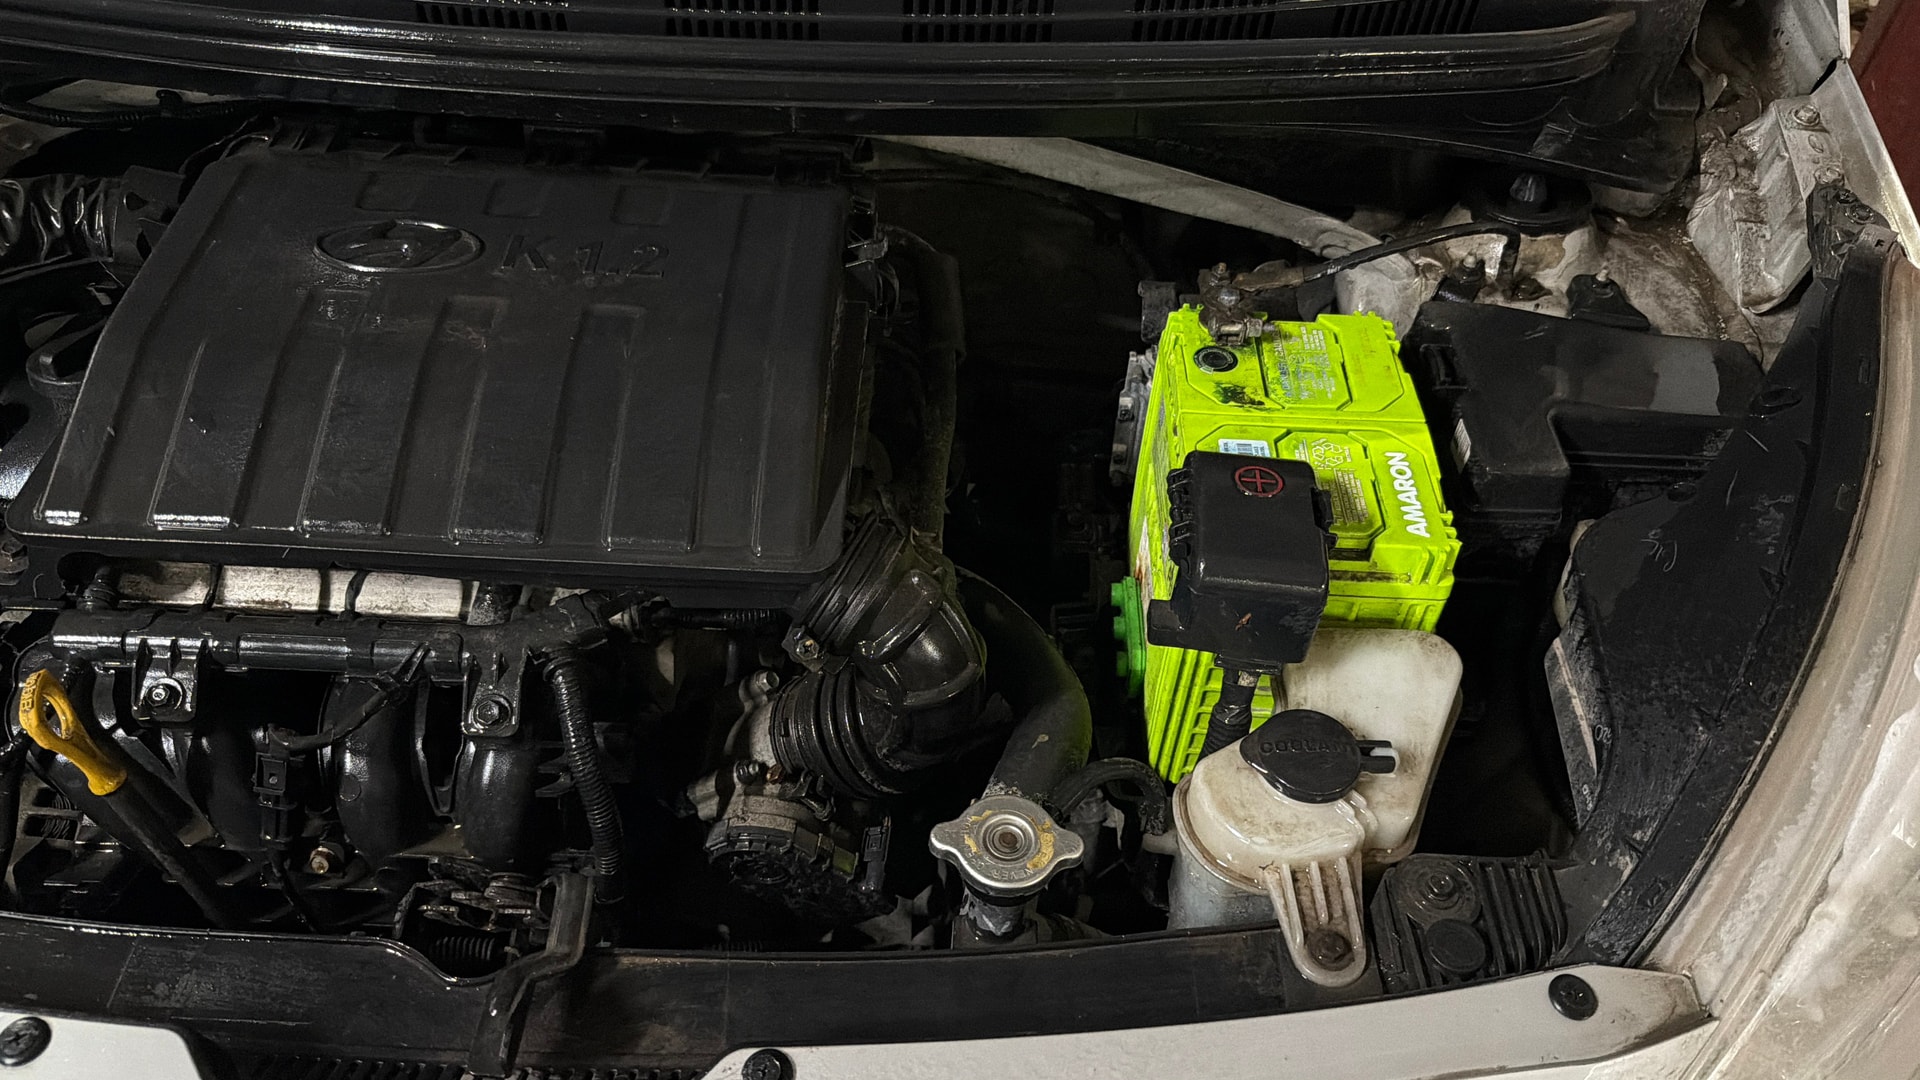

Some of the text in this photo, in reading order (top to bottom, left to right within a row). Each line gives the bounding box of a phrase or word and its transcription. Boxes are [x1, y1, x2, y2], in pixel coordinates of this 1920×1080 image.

[501, 235, 672, 279] K 1.2
[1384, 452, 1431, 538] AMARON
